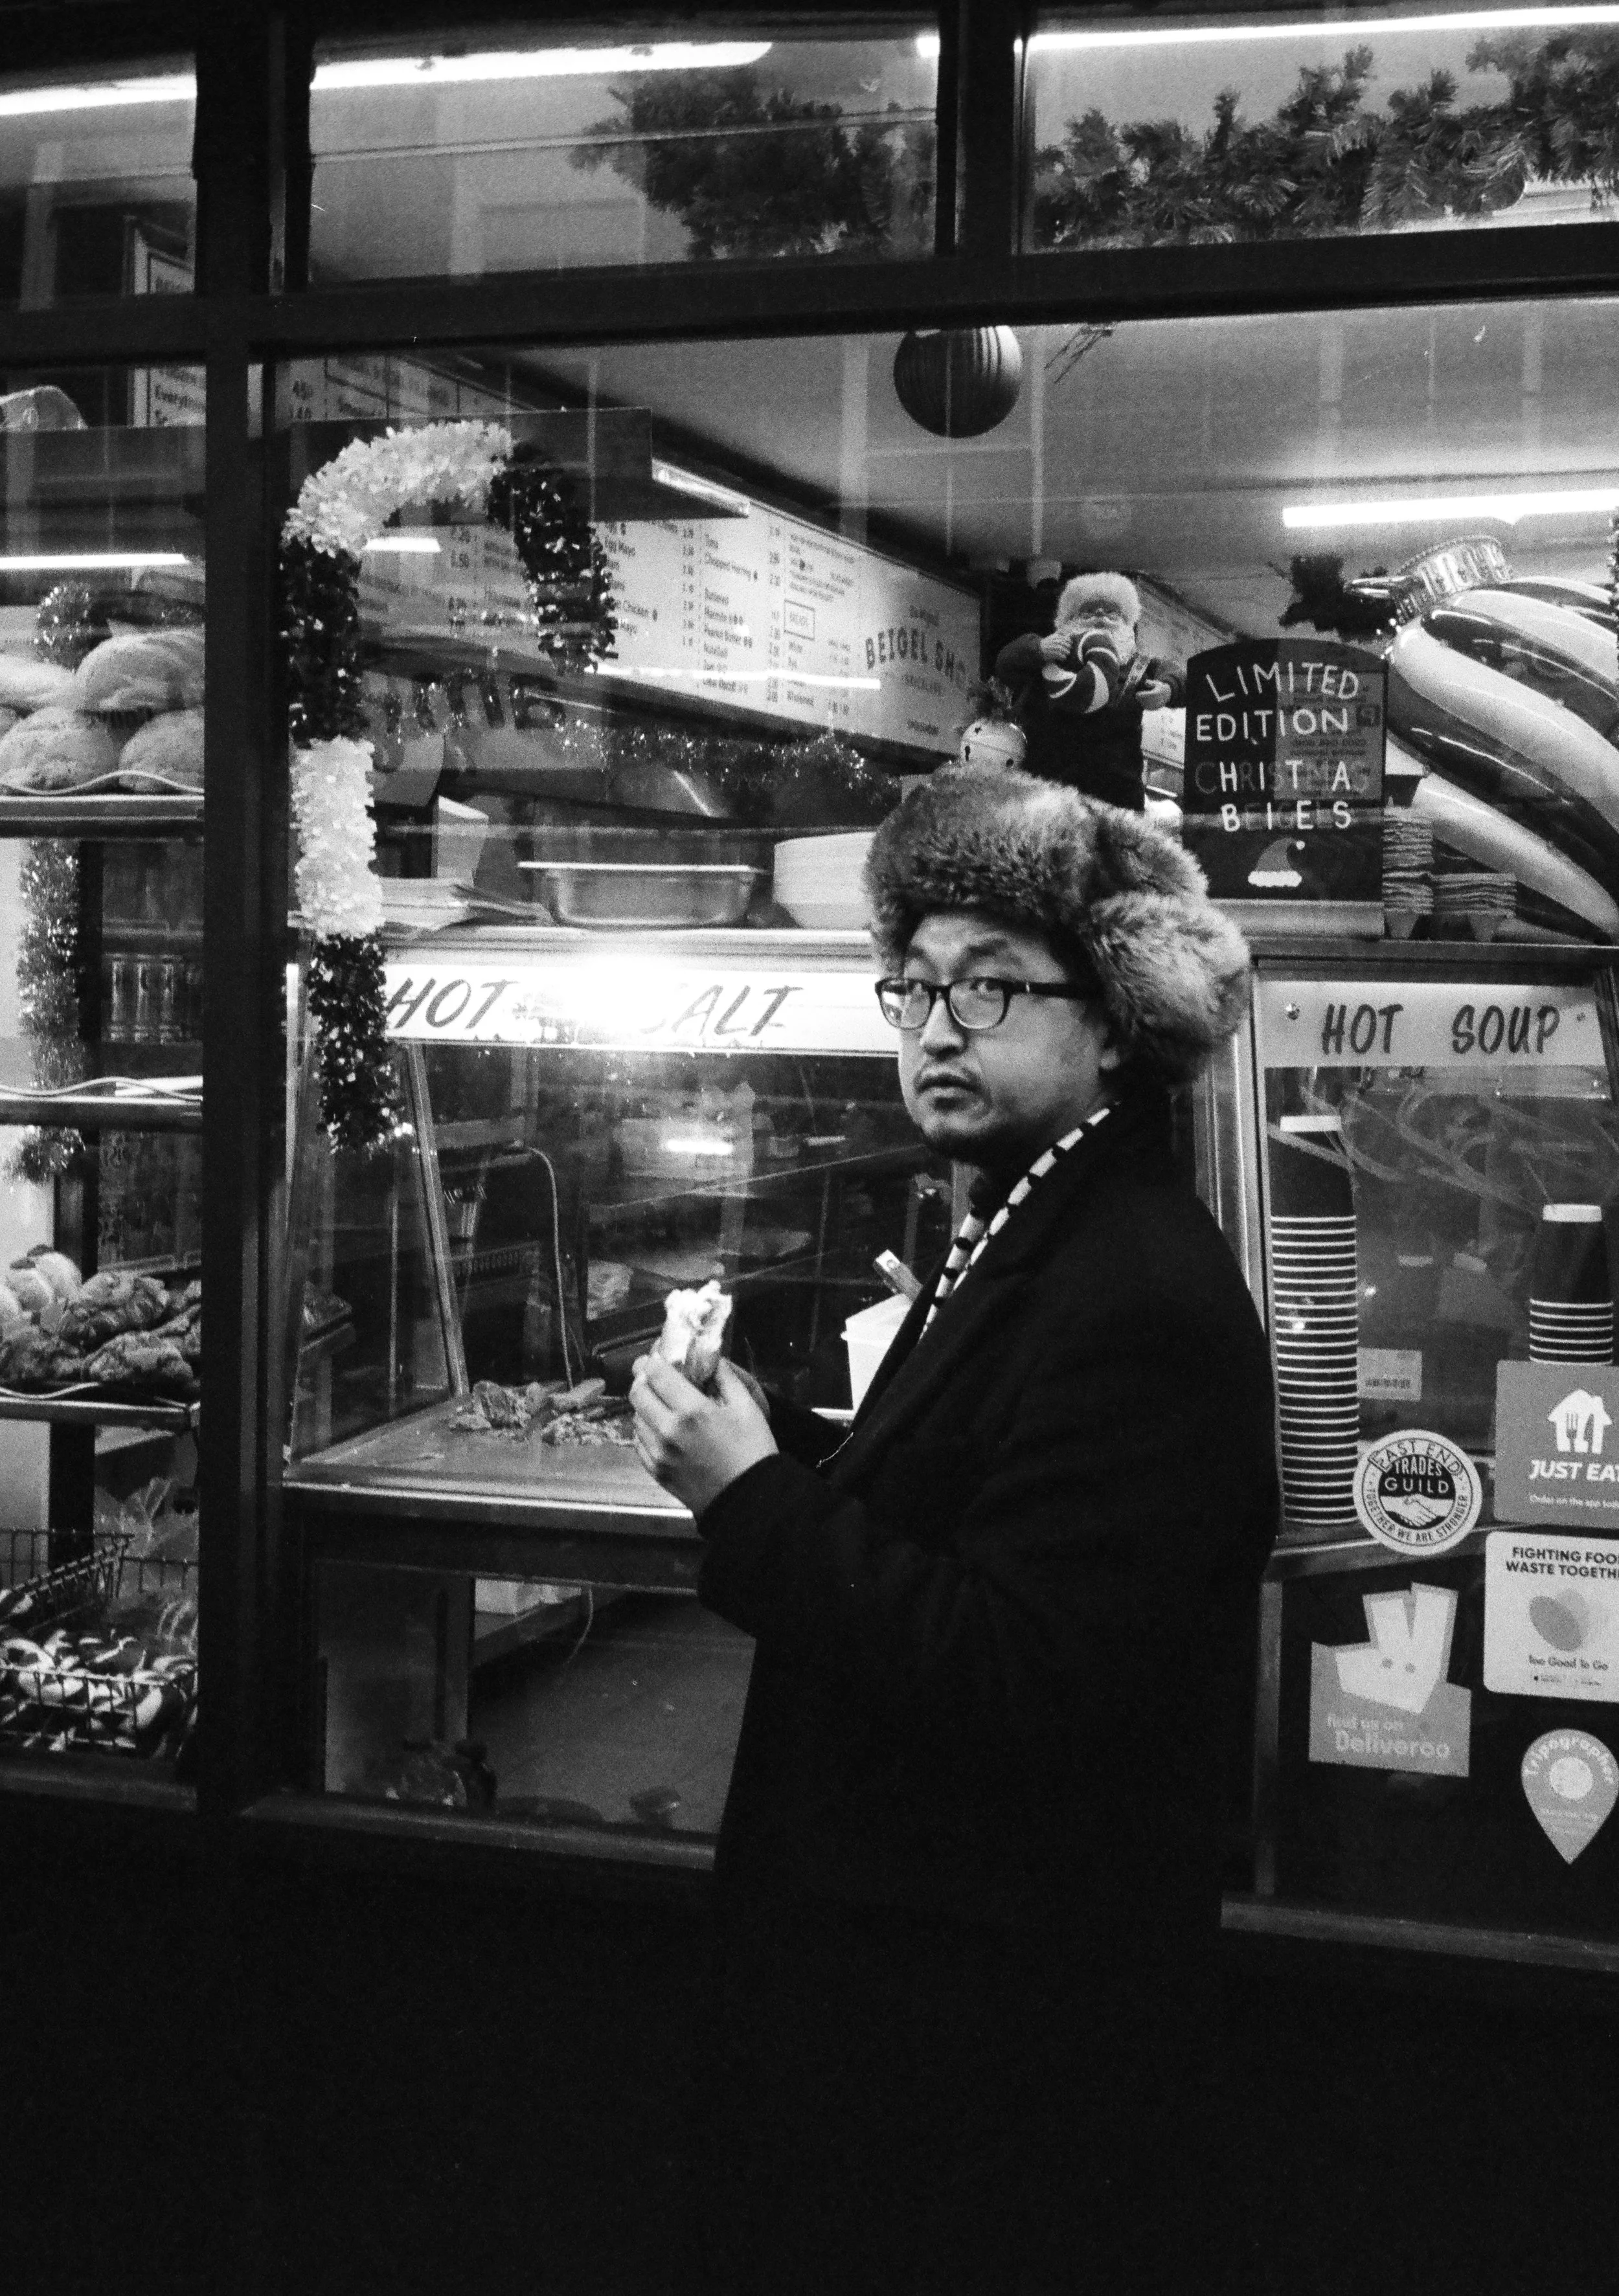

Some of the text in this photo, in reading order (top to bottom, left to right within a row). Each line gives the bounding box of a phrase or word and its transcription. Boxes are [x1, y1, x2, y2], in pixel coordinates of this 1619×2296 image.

[865, 627, 927, 670] BEIGEL
[1206, 661, 1359, 703] LIMITED
[1196, 708, 1348, 742] EDITION
[386, 977, 804, 1037] HOT ALT
[1321, 1003, 1561, 1055] HOT SOUP
[1367, 1440, 1464, 1476] EAST END
[1394, 1456, 1443, 1477] TRADES
[1529, 1459, 1583, 1480] JUST
[1384, 1477, 1449, 1494] GUILD
[1397, 1528, 1412, 1540] WE
[1416, 1532, 1433, 1542] ARE
[1436, 1494, 1469, 1538] STRONGER
[1506, 1560, 1619, 1579] WASTE TOGETH
[1512, 1546, 1619, 1565] FIGHTING FOO
[1548, 1656, 1576, 1669] Good
[1592, 1660, 1609, 1671] Go
